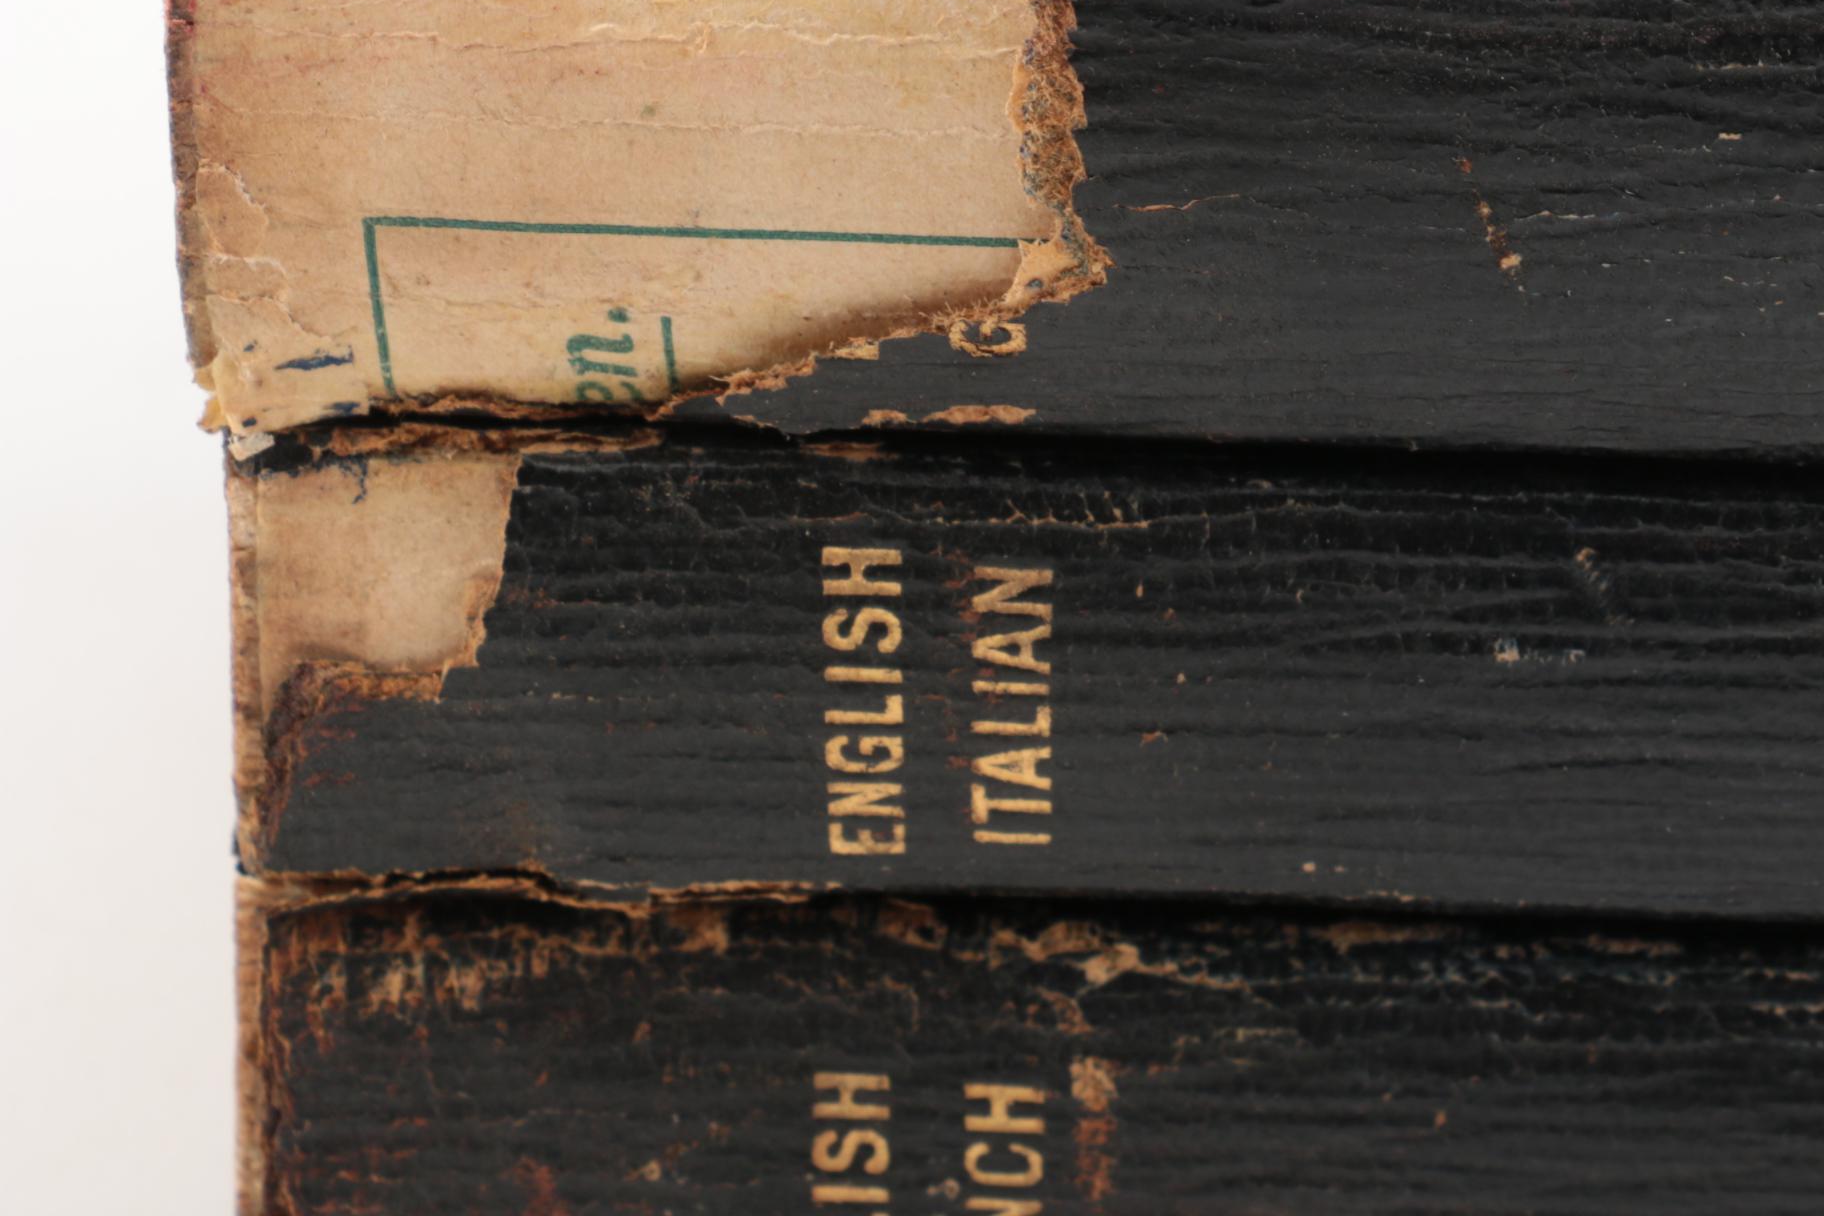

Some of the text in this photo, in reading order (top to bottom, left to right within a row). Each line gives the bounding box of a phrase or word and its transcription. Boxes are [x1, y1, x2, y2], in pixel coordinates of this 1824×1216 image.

[822, 546, 904, 854] ENGLISH
[971, 567, 1053, 844] ITALIAN
[812, 1072, 890, 1216] ISH
